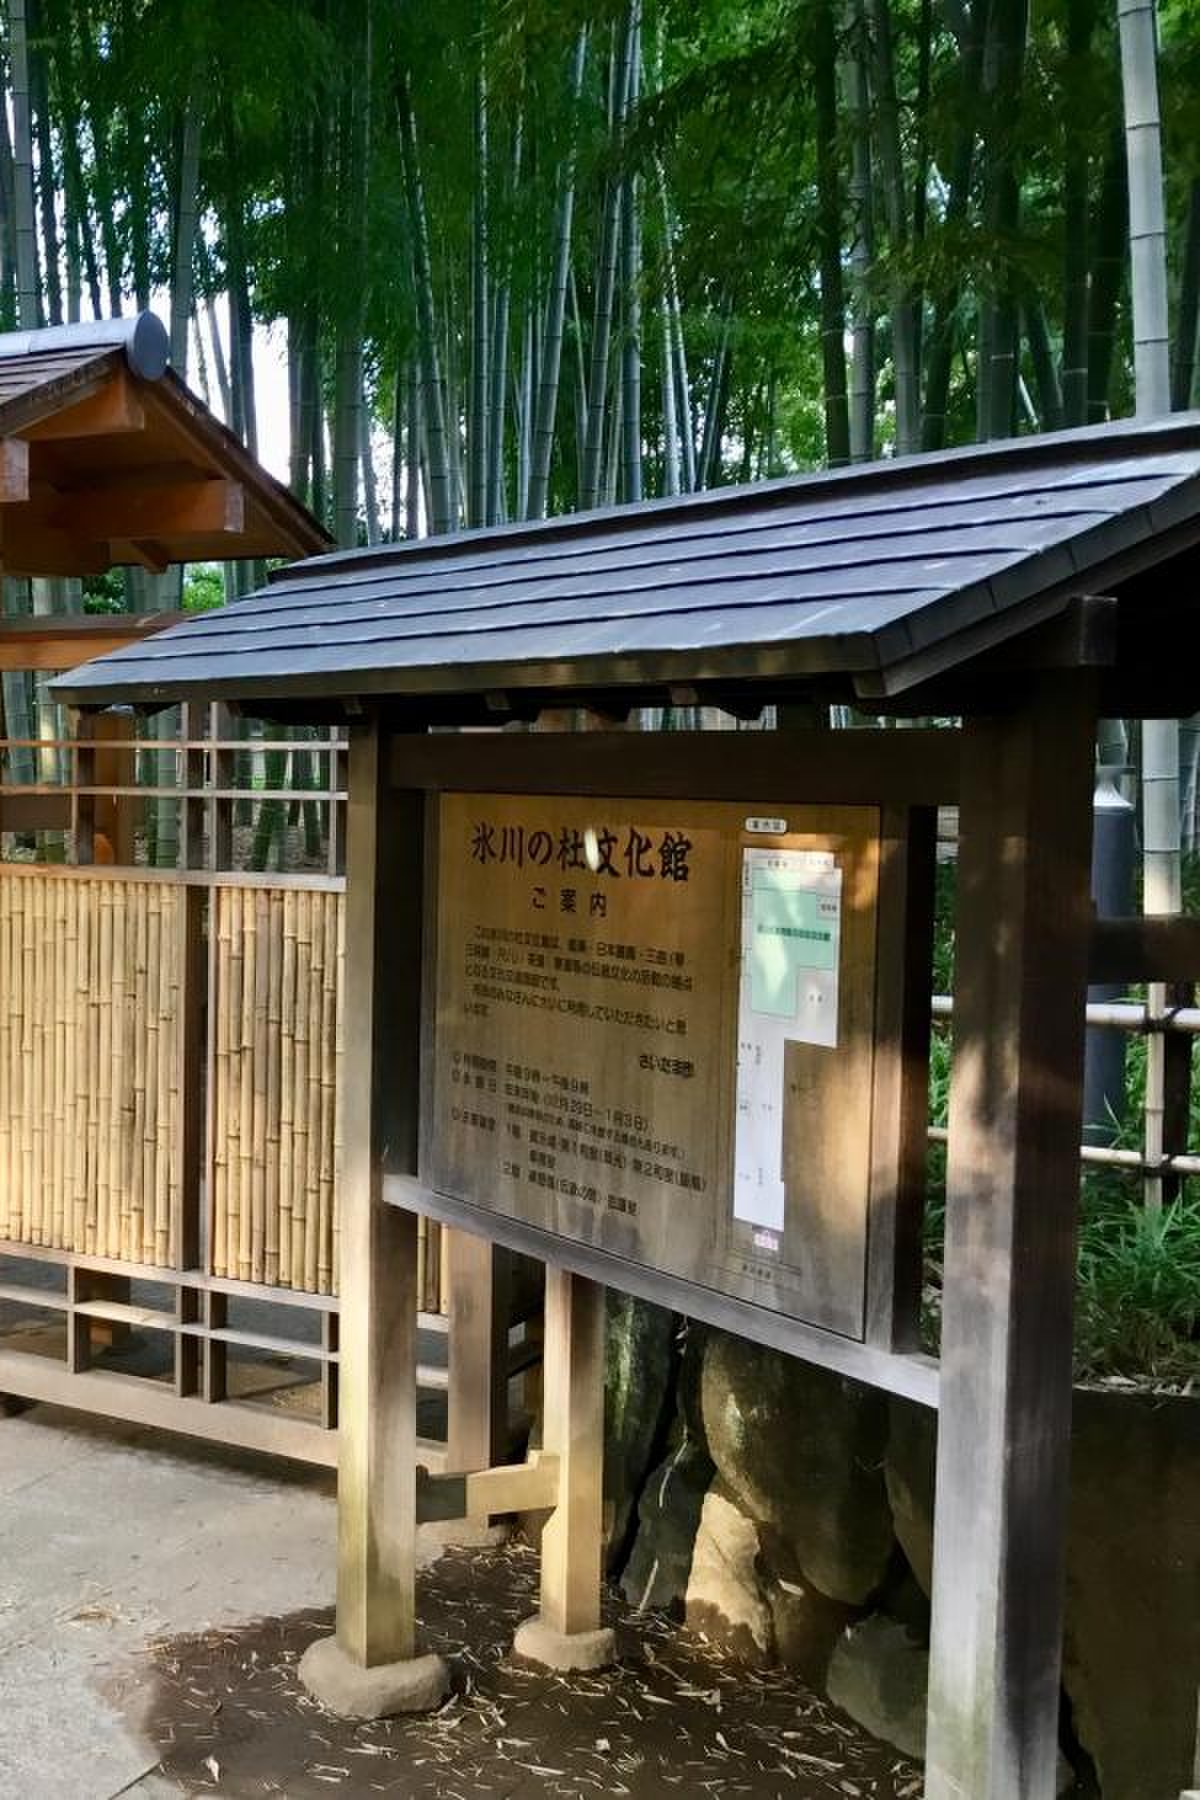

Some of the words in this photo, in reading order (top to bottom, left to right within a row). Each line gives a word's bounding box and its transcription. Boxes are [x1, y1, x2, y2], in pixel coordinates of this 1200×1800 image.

[471, 820, 692, 882] 氷川の杜文化館
[531, 886, 607, 917] ご案内
